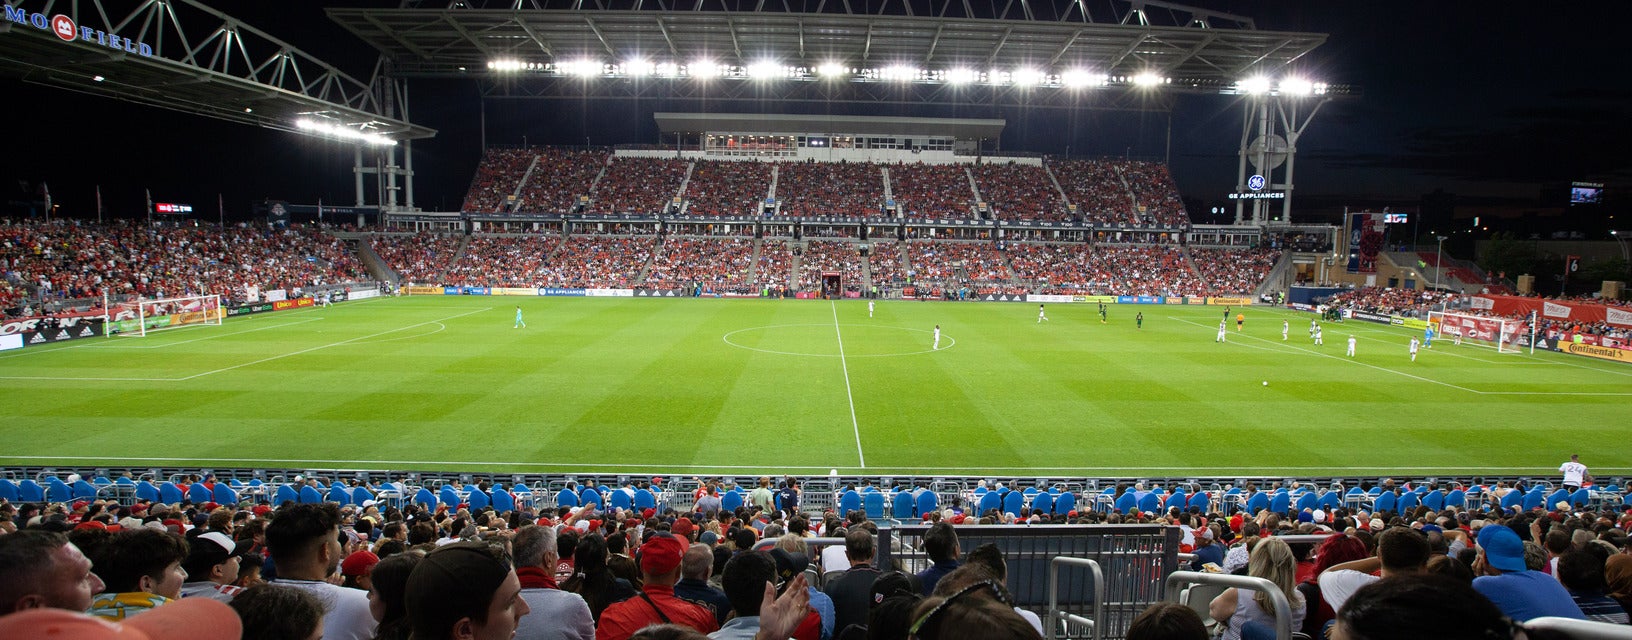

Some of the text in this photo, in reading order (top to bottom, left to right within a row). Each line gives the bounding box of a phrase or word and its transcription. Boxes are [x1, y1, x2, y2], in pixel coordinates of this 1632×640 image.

[80, 25, 153, 57] FIELD
[1570, 260, 1578, 272] 6
[1569, 343, 1616, 358] Continental
[1567, 465, 1582, 474] 24
